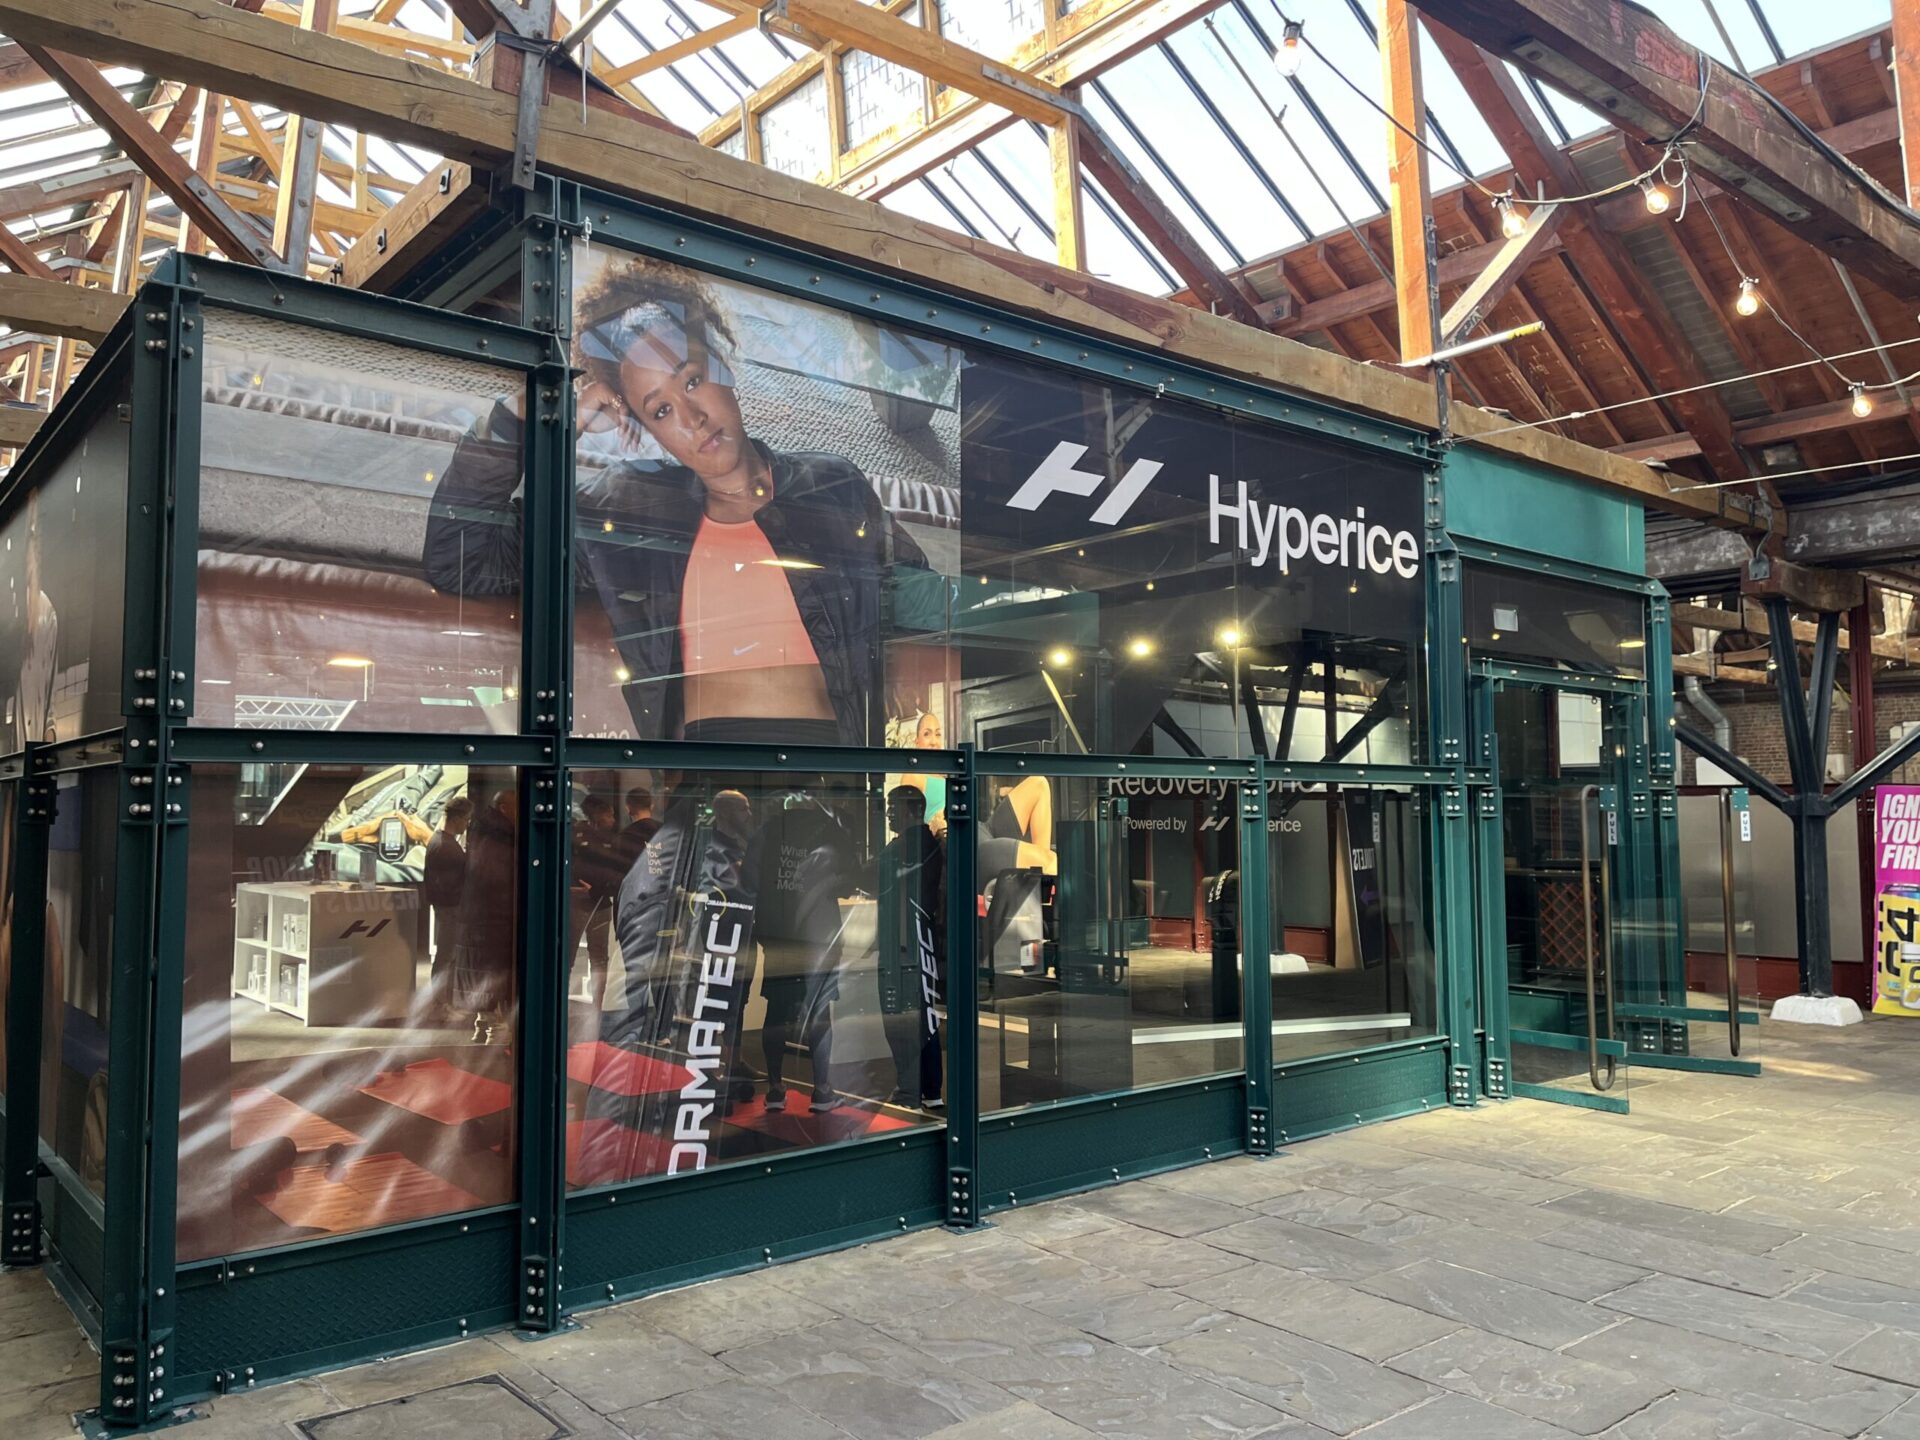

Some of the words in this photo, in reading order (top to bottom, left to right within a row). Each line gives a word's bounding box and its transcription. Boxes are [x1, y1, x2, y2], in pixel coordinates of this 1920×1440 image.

[1209, 474, 1419, 579] Hyperice
[1108, 777, 1227, 800] Recovery
[1125, 816, 1171, 831] Powered
[1173, 816, 1187, 833] by
[1267, 816, 1302, 832] erice
[1742, 813, 1750, 838] PUSH
[668, 918, 742, 1176] ORMATEC
